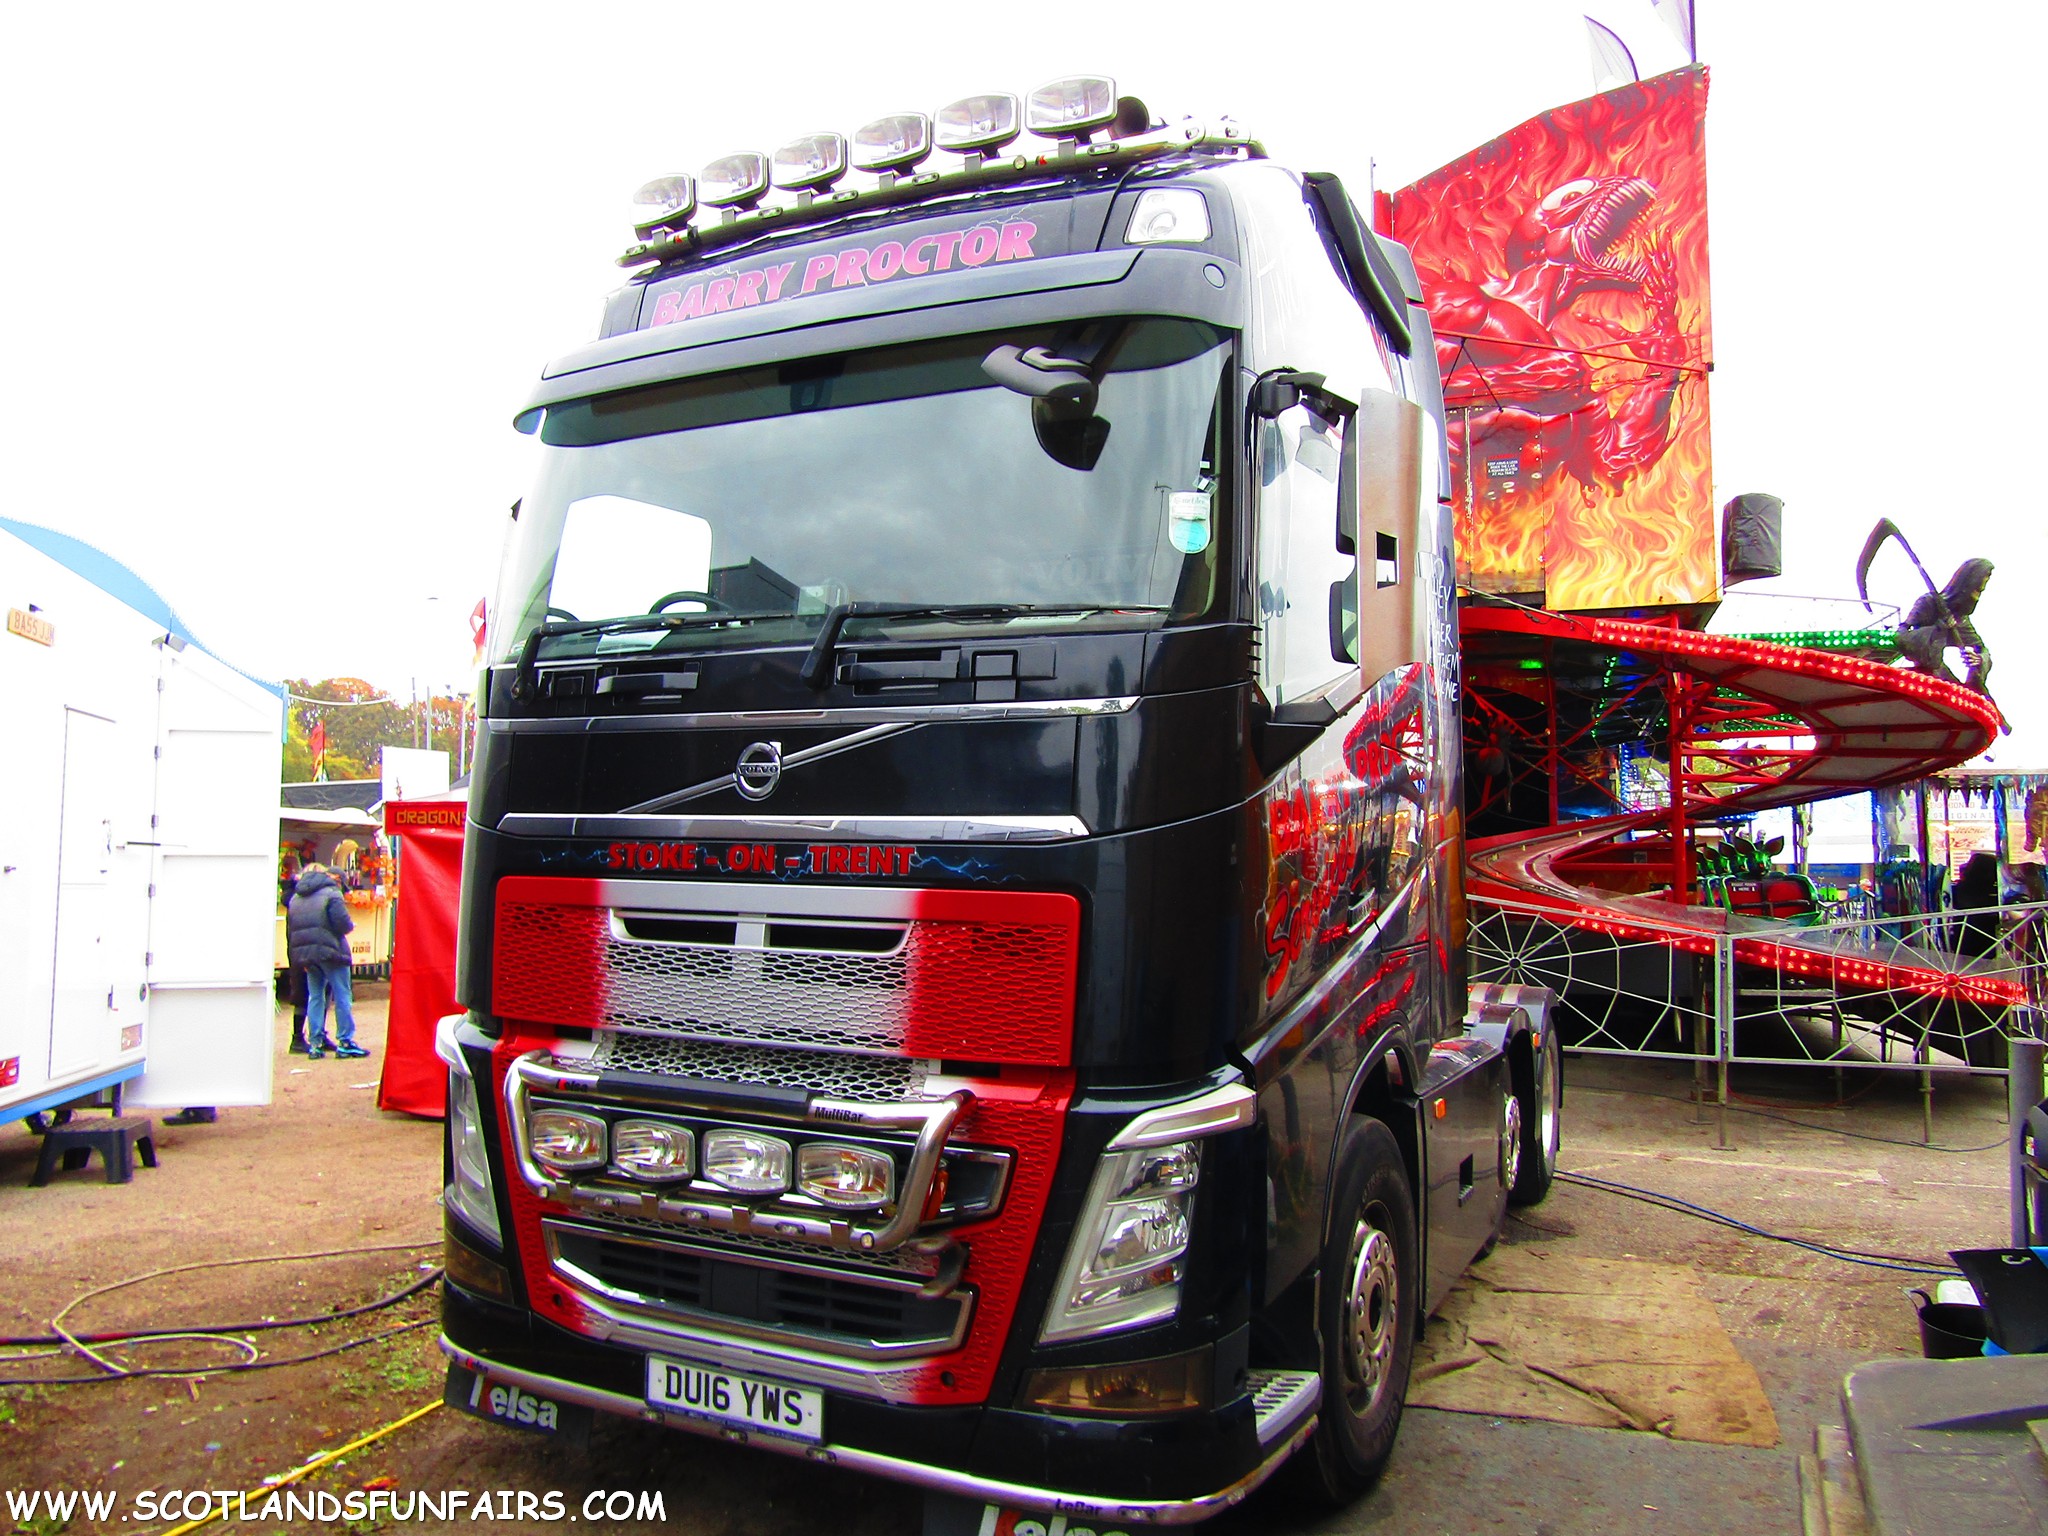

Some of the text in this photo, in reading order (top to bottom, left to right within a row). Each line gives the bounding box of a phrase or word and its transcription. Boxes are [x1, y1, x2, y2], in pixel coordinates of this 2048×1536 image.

[650, 221, 1038, 328] BARRY PROCTOR
[606, 842, 697, 871] STOKE
[727, 844, 776, 874] ON
[807, 844, 917, 876] TRENT
[814, 1106, 864, 1124] MultiBar
[664, 1365, 730, 1411] DU16
[741, 1381, 803, 1426] YWS
